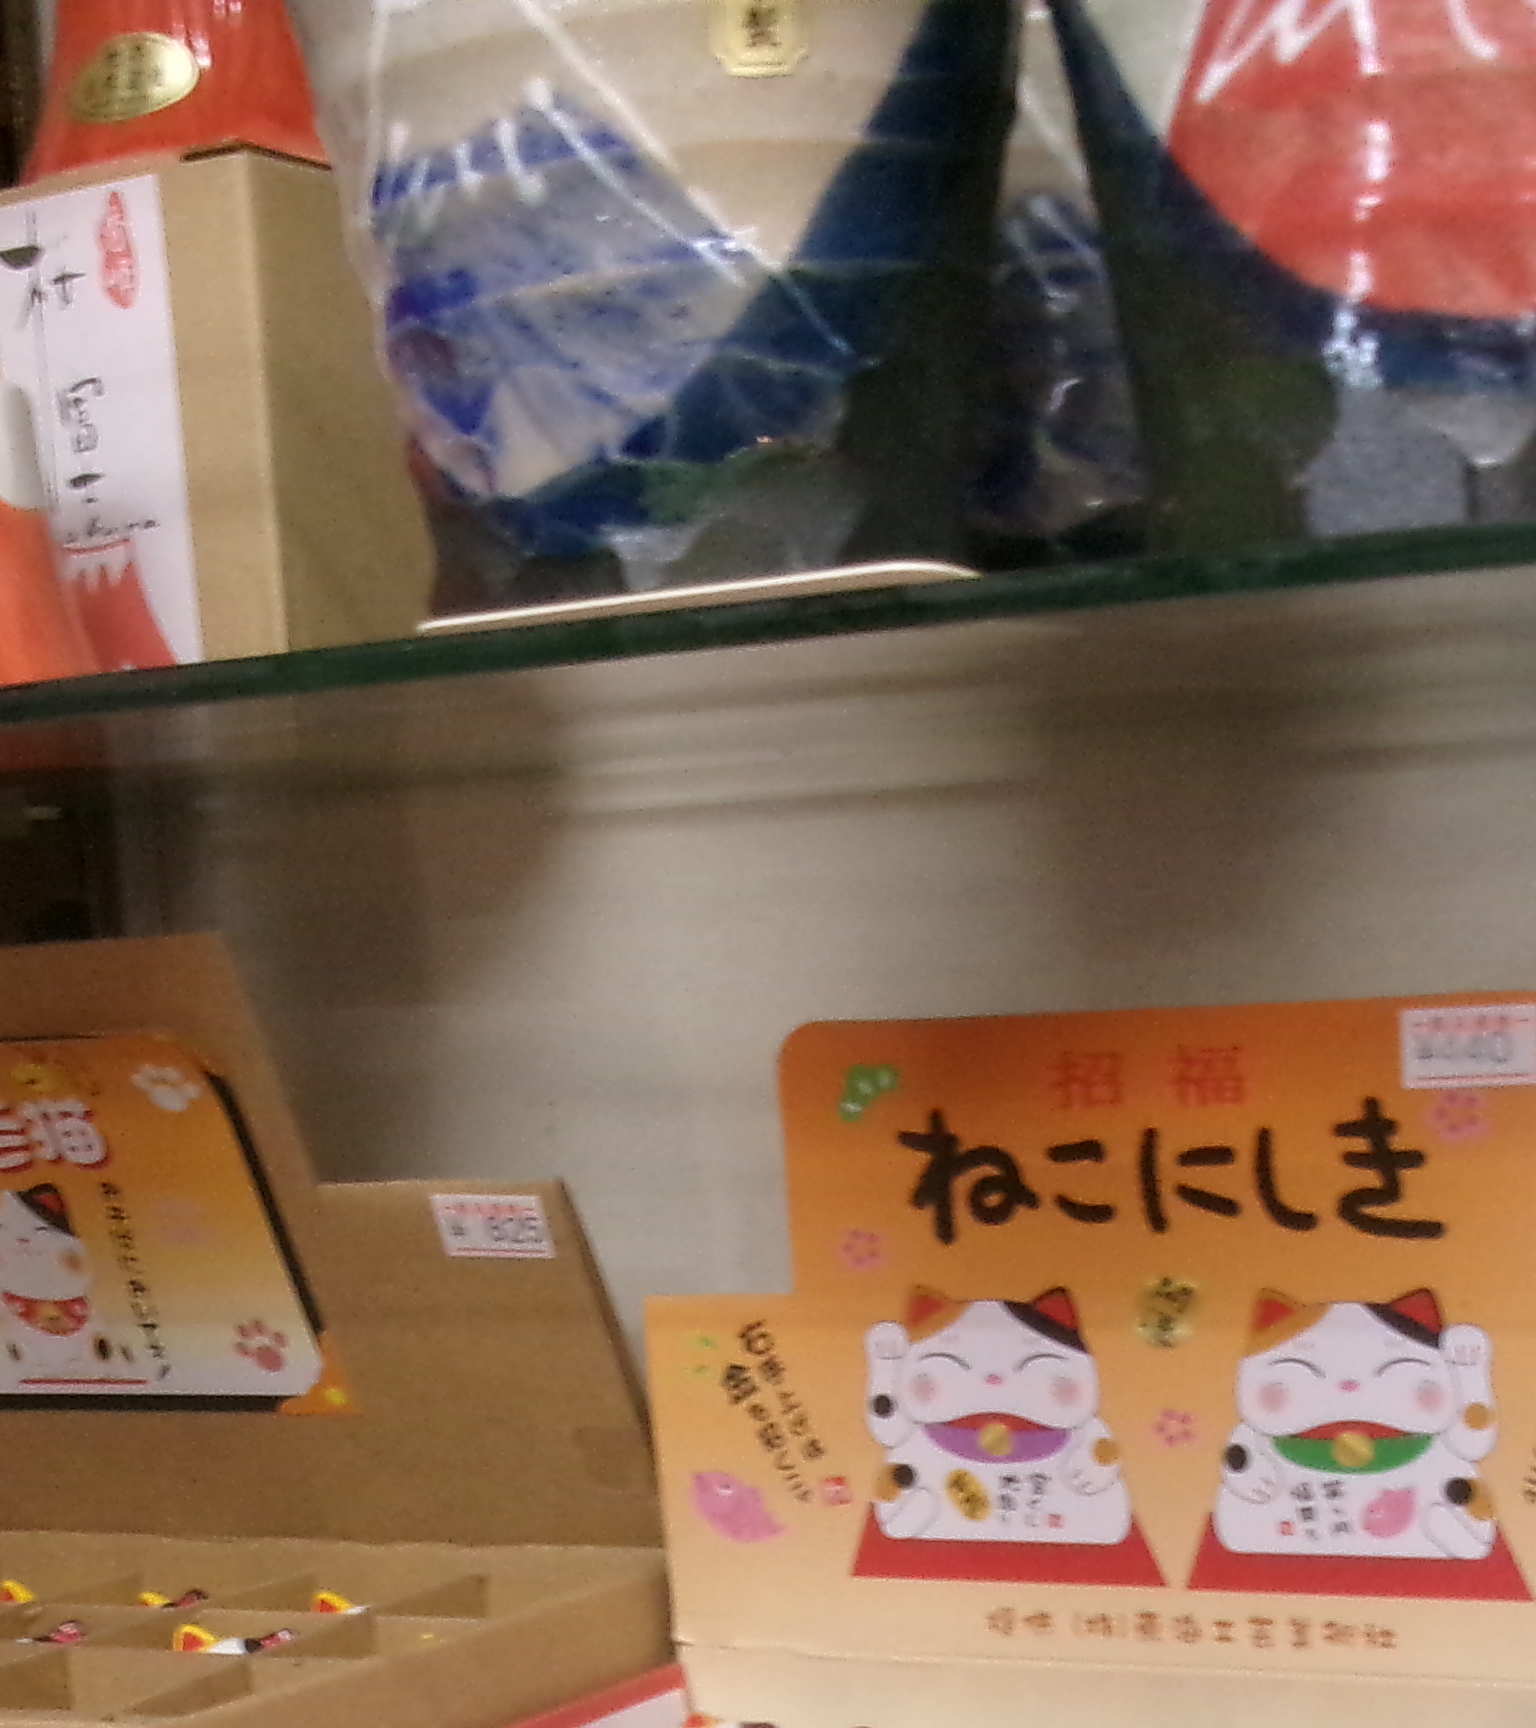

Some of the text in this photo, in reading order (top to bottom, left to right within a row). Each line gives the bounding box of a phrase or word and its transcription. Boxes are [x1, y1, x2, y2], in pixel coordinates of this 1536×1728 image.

[1050, 1043, 1246, 1109] 招福
[898, 1095, 1447, 1243] ねこにしき
